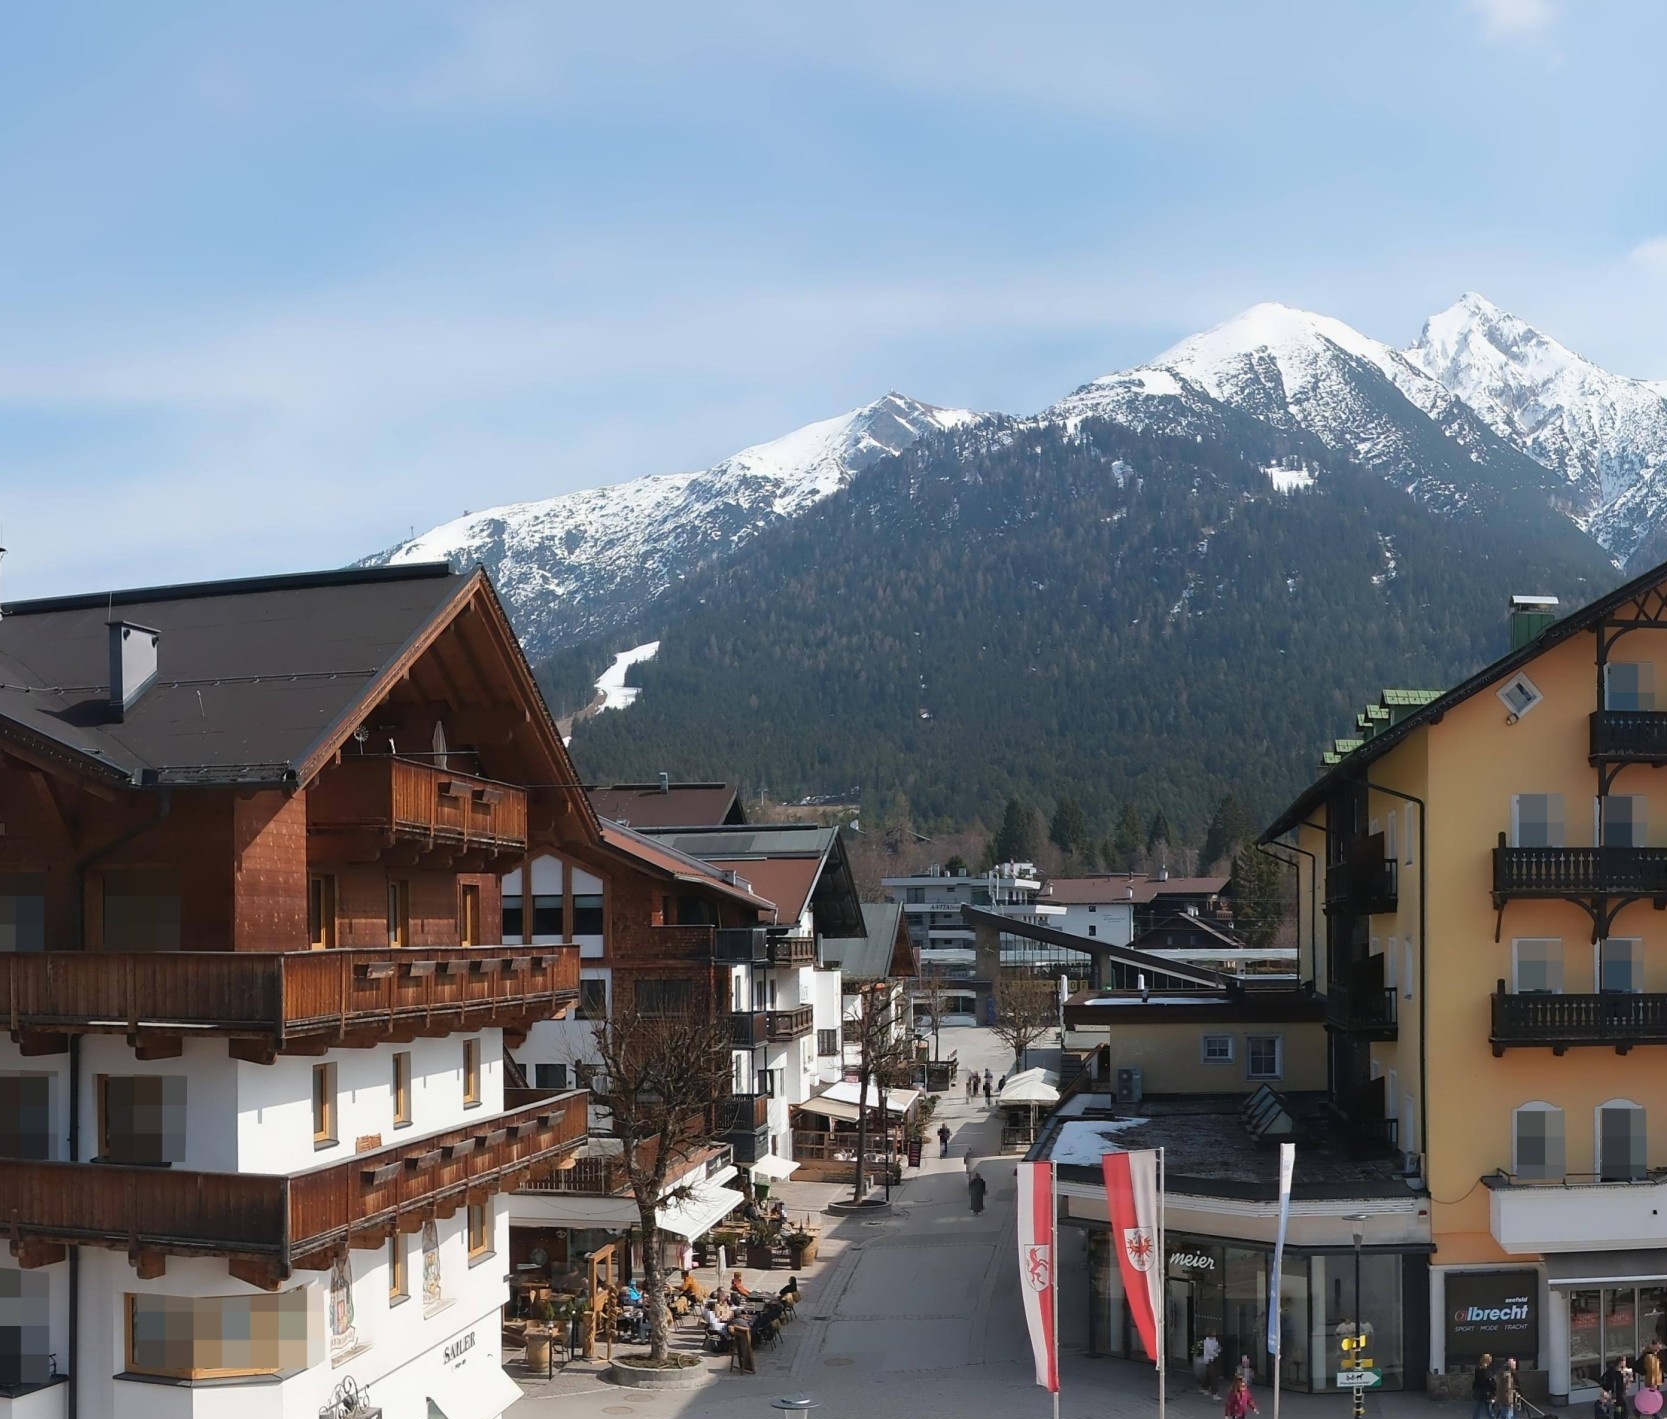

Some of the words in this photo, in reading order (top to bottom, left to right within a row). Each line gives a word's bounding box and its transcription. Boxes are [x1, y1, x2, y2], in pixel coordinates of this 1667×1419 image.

[1170, 1250, 1216, 1270] meier
[1504, 1323, 1529, 1331] TRACHT
[443, 1331, 476, 1365] SAILER
